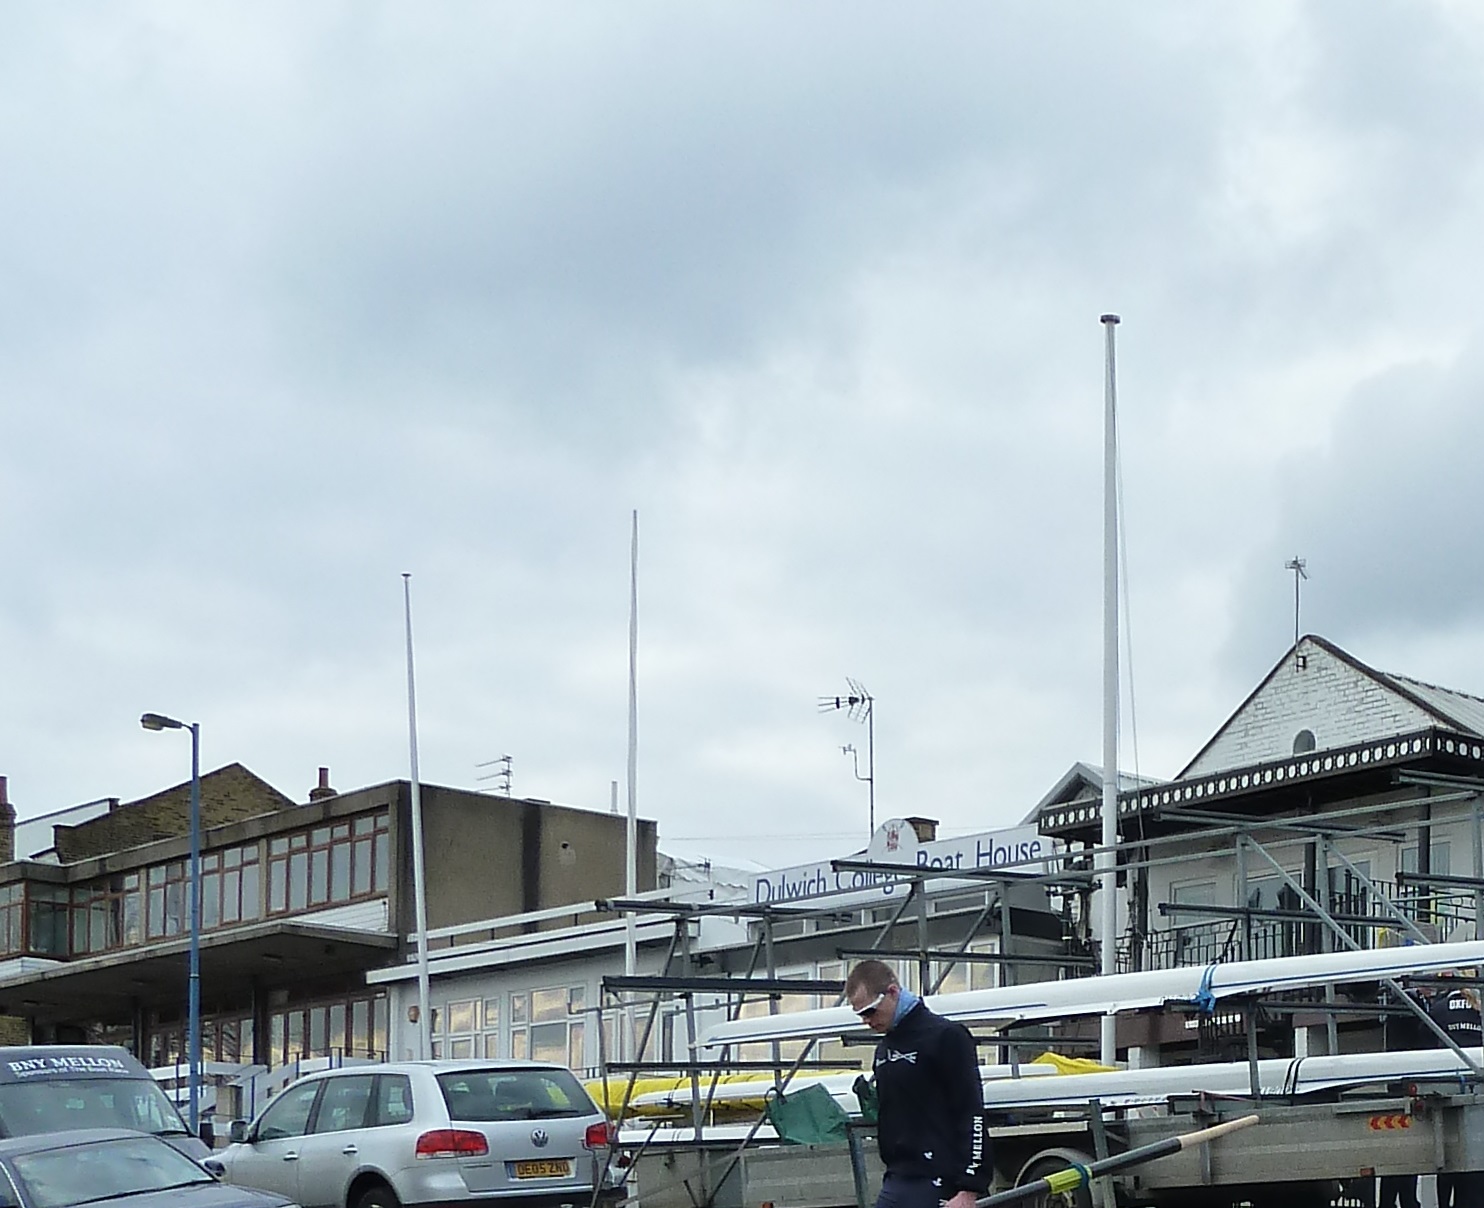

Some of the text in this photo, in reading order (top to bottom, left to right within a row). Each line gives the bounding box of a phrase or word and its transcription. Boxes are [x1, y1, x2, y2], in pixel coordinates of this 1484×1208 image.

[756, 838, 1042, 904] Dulwich Colleg Boat House
[1460, 1022, 1482, 1032] MELLO
[8, 1057, 125, 1072] BNY MELLON
[973, 1116, 984, 1160] MELLON
